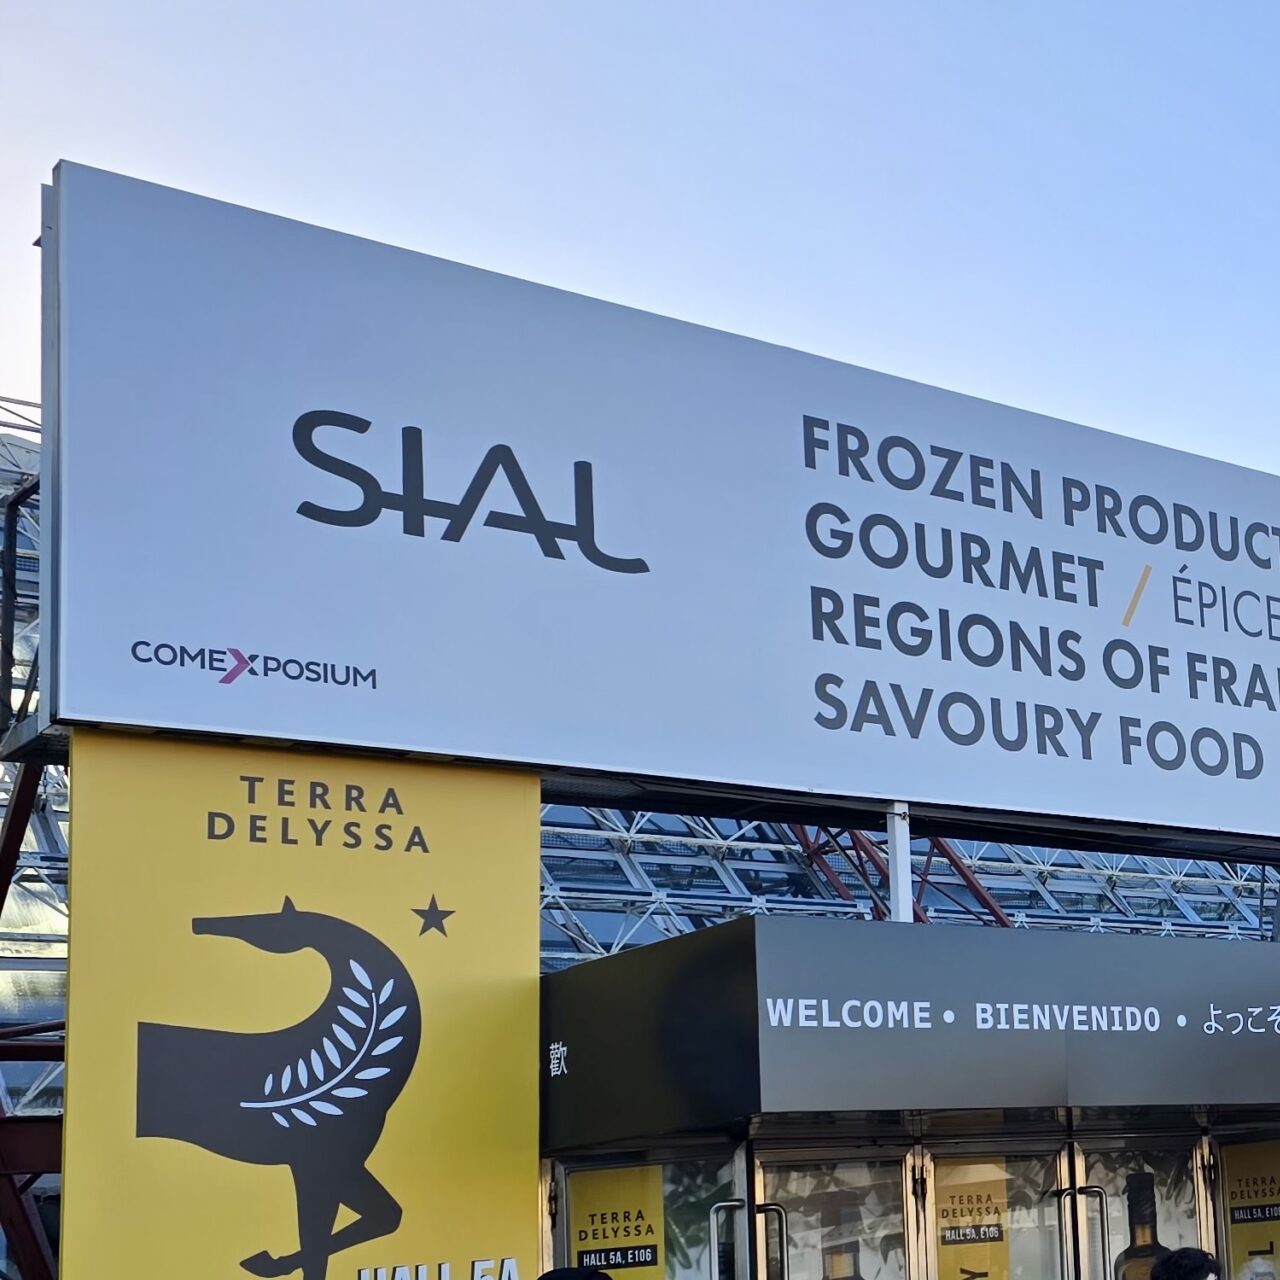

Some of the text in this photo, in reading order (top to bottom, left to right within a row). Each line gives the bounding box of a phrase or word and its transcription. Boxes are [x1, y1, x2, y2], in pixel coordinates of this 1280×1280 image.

[802, 414, 1044, 520] FROZEN
[292, 409, 651, 574] SIAL
[804, 502, 1104, 608] GOURMET
[810, 585, 1086, 682] REGIONS
[1102, 638, 1170, 694] OF
[131, 640, 378, 690] COMEXPOSIUM
[813, 672, 1102, 762] SAVOURY
[1119, 715, 1265, 781] FOOD
[240, 774, 404, 815] TERRA
[206, 810, 430, 854] DELYSSA
[765, 997, 932, 1030] WELCOME
[975, 1002, 1161, 1032] BIENVENIDO
[948, 1192, 993, 1206] TERRA
[1237, 1176, 1277, 1189] TERRA
[588, 1209, 645, 1226] TERRA
[941, 1205, 1001, 1219] DELYSSA
[1234, 1208, 1252, 1220] HALL
[578, 1223, 655, 1242] DELYSSA
[945, 1228, 965, 1241] HALL
[583, 1250, 608, 1267] HALL
[627, 1248, 652, 1263] E106
